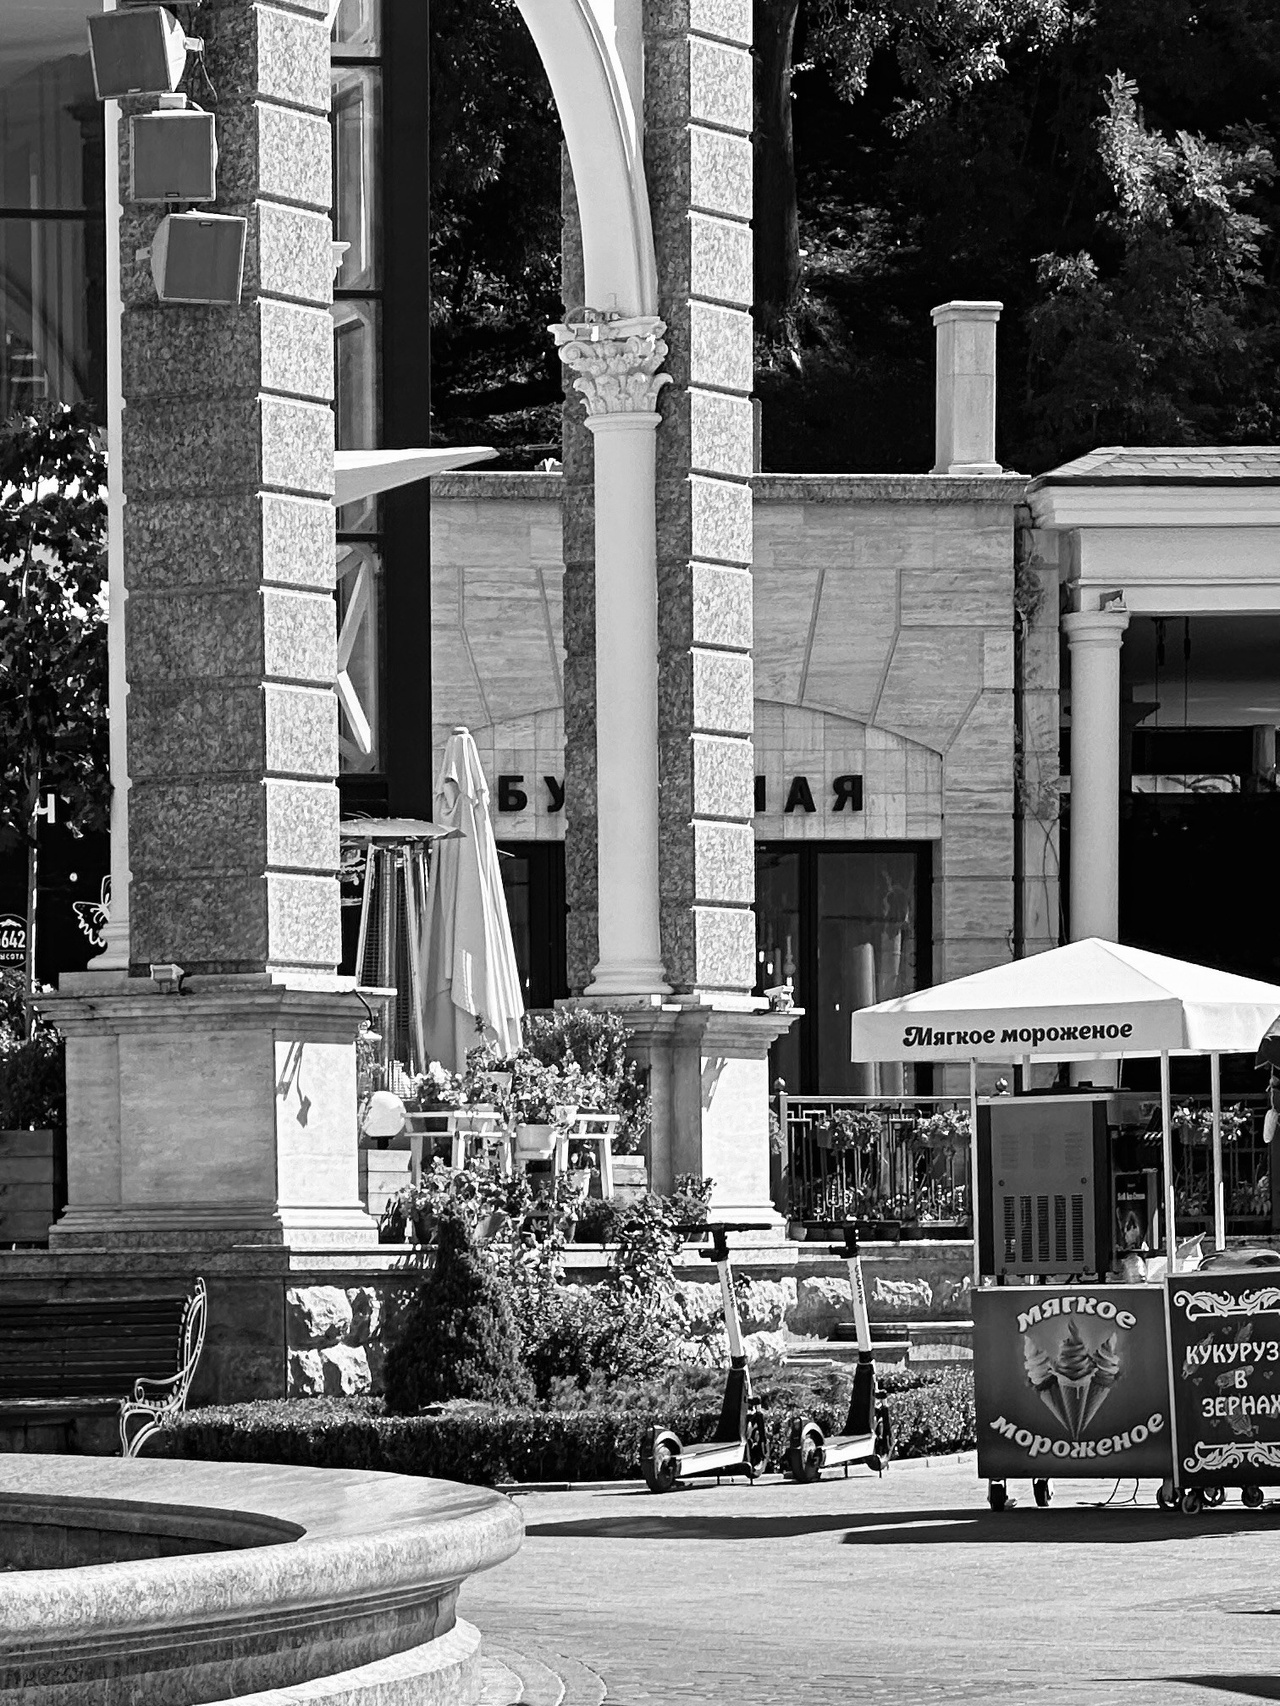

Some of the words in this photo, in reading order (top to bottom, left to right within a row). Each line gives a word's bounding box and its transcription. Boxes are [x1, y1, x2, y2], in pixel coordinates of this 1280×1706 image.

[902, 1026, 996, 1047] Мягкое
[1000, 1023, 1133, 1047] мороженое
[1186, 1341, 1280, 1365] КУКУРУЗ
[1234, 1370, 1248, 1389] В
[1202, 1394, 1280, 1417] ЗЕРНАХ
[989, 1412, 1166, 1459] мороженое
